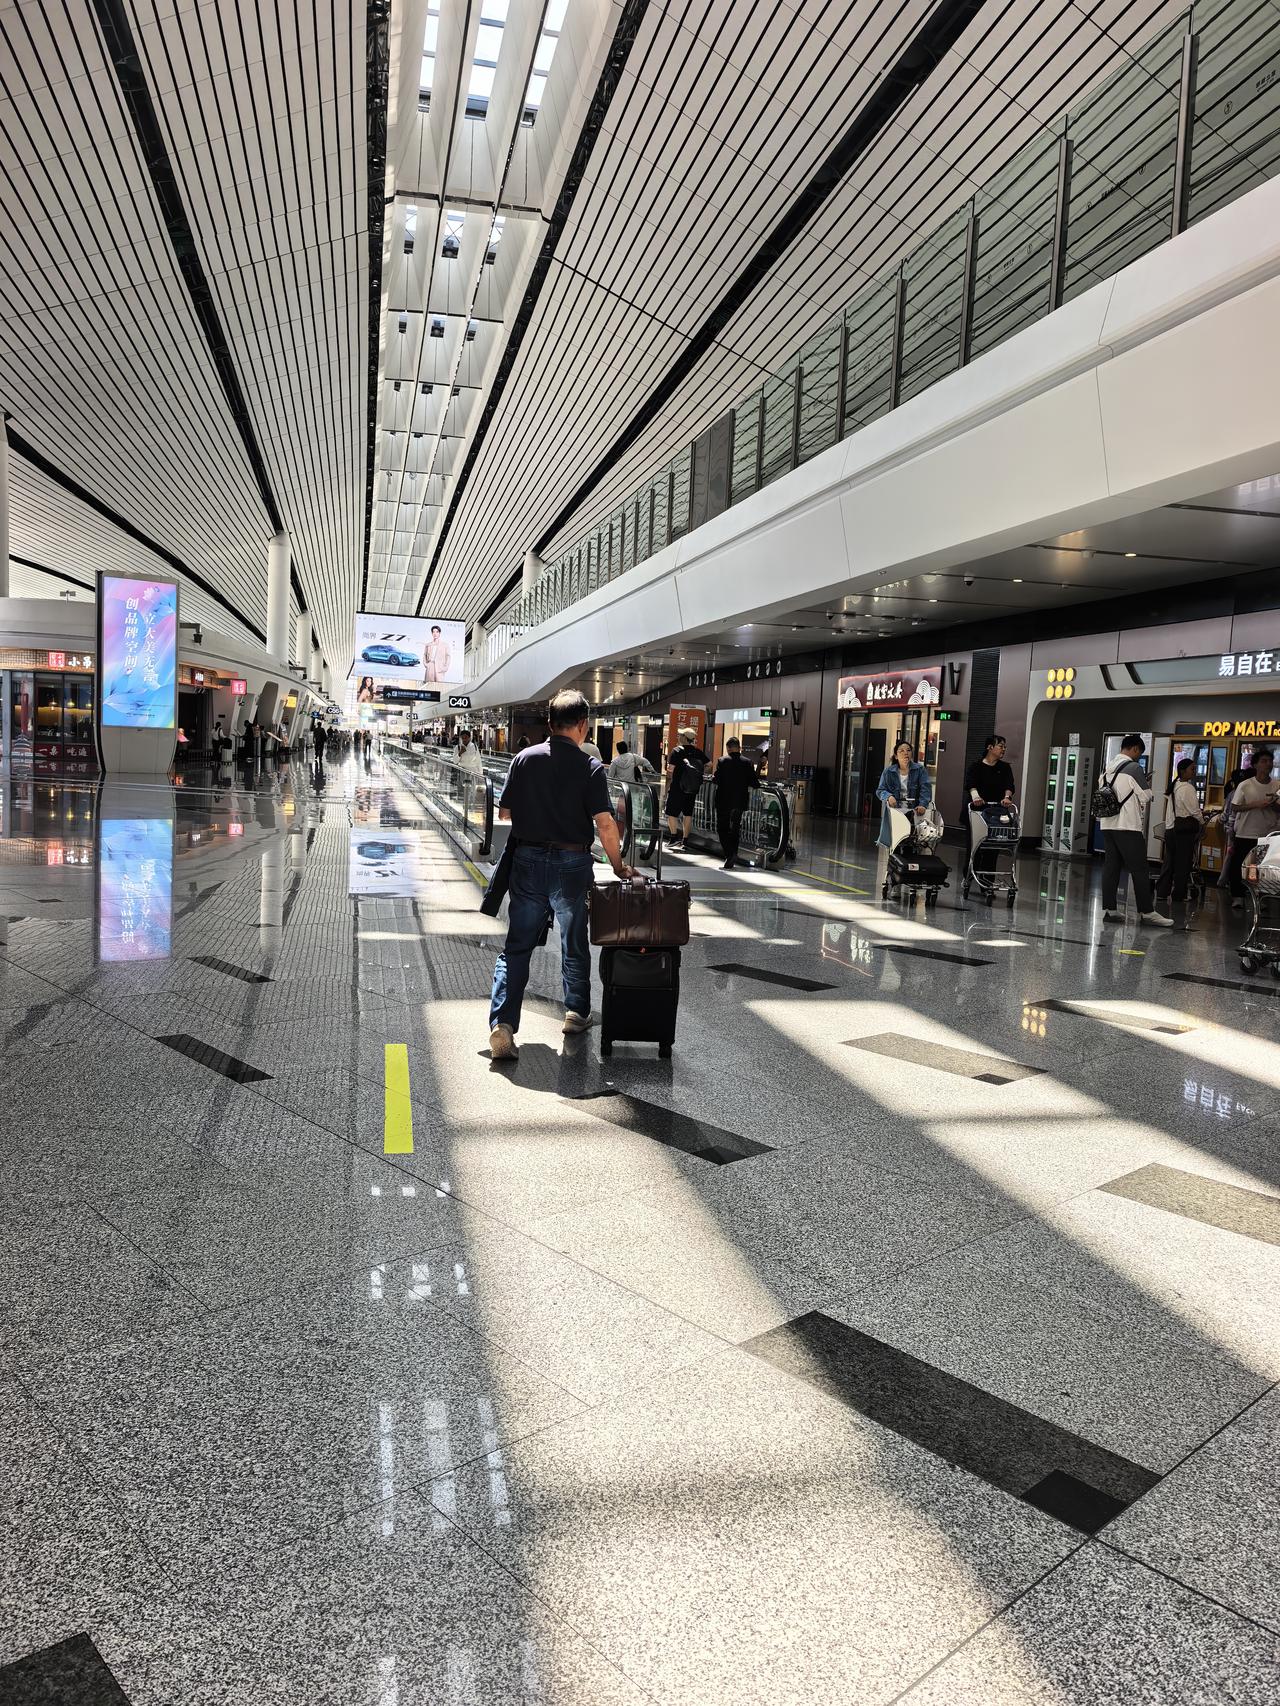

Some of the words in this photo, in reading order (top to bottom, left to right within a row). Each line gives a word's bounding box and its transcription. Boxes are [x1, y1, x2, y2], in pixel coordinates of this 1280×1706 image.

[124, 597, 139, 668] 创品牌空间
[1219, 651, 1273, 676] 易自在
[450, 697, 468, 707] C40
[1203, 721, 1230, 736] POP
[1234, 721, 1276, 736] MART
